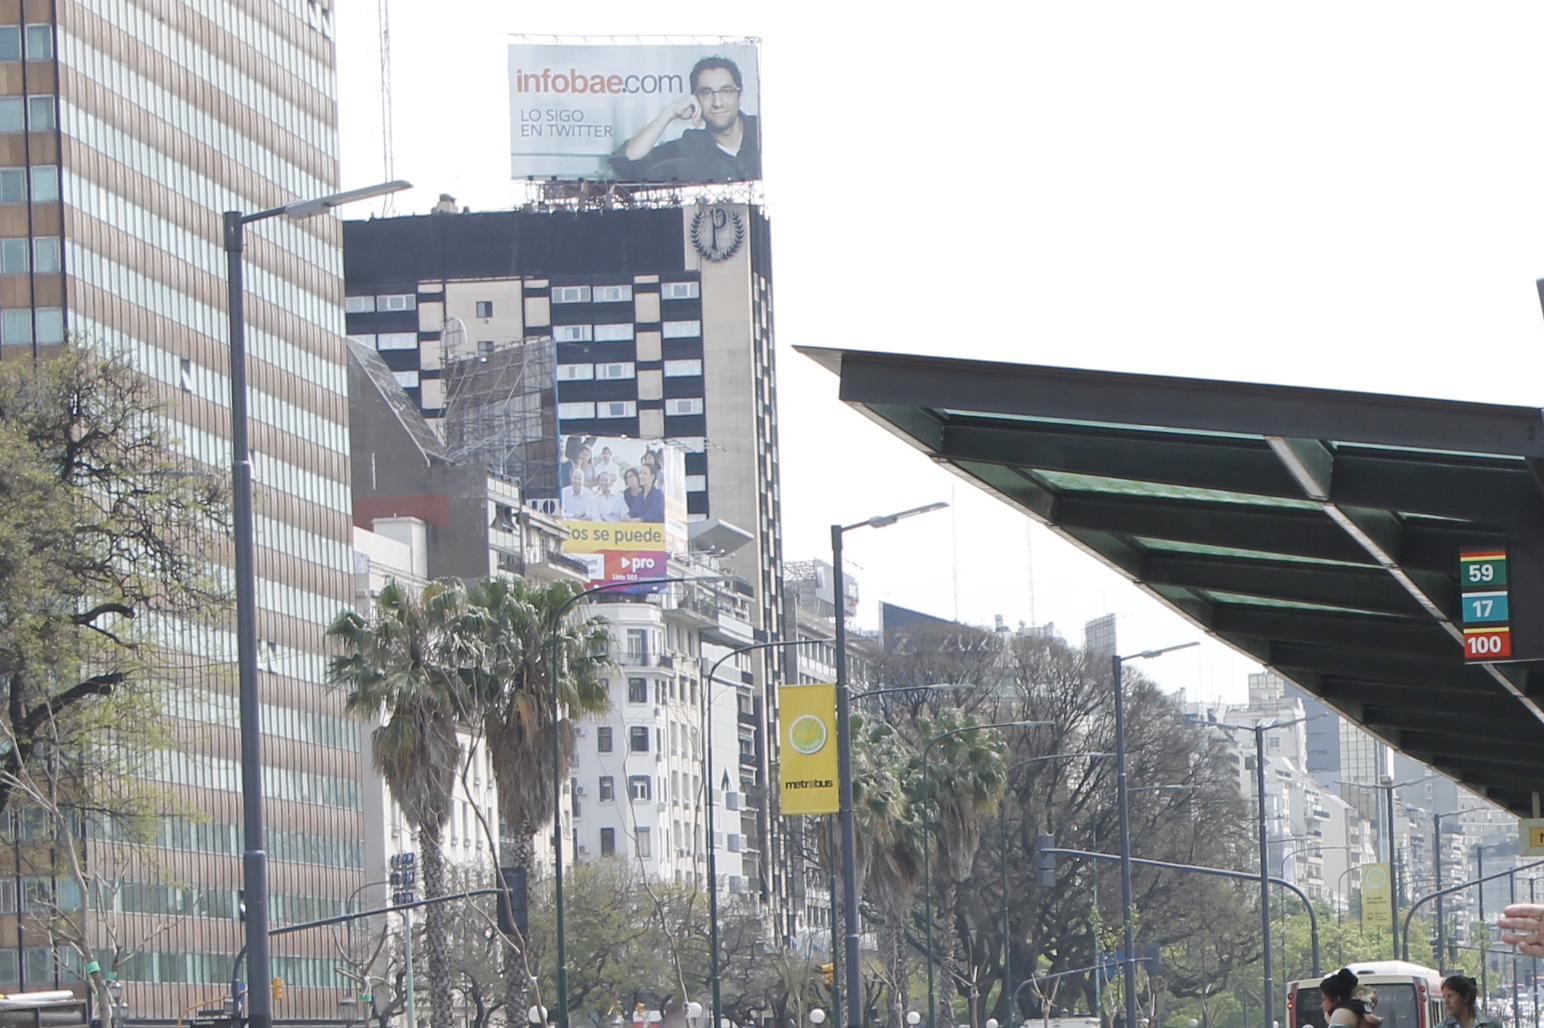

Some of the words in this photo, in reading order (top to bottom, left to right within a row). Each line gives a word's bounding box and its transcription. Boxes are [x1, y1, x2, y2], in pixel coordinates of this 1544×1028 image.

[516, 68, 684, 94] infobae.com
[521, 109, 542, 123] LO
[546, 109, 585, 123] SIGO
[521, 125, 543, 138] EN
[549, 125, 614, 138] TWITTER
[593, 529, 611, 541] se
[614, 526, 666, 545] puede.
[632, 557, 655, 573] pro
[1469, 564, 1494, 582] 59
[1473, 599, 1493, 618] 17
[1468, 635, 1502, 654] 100
